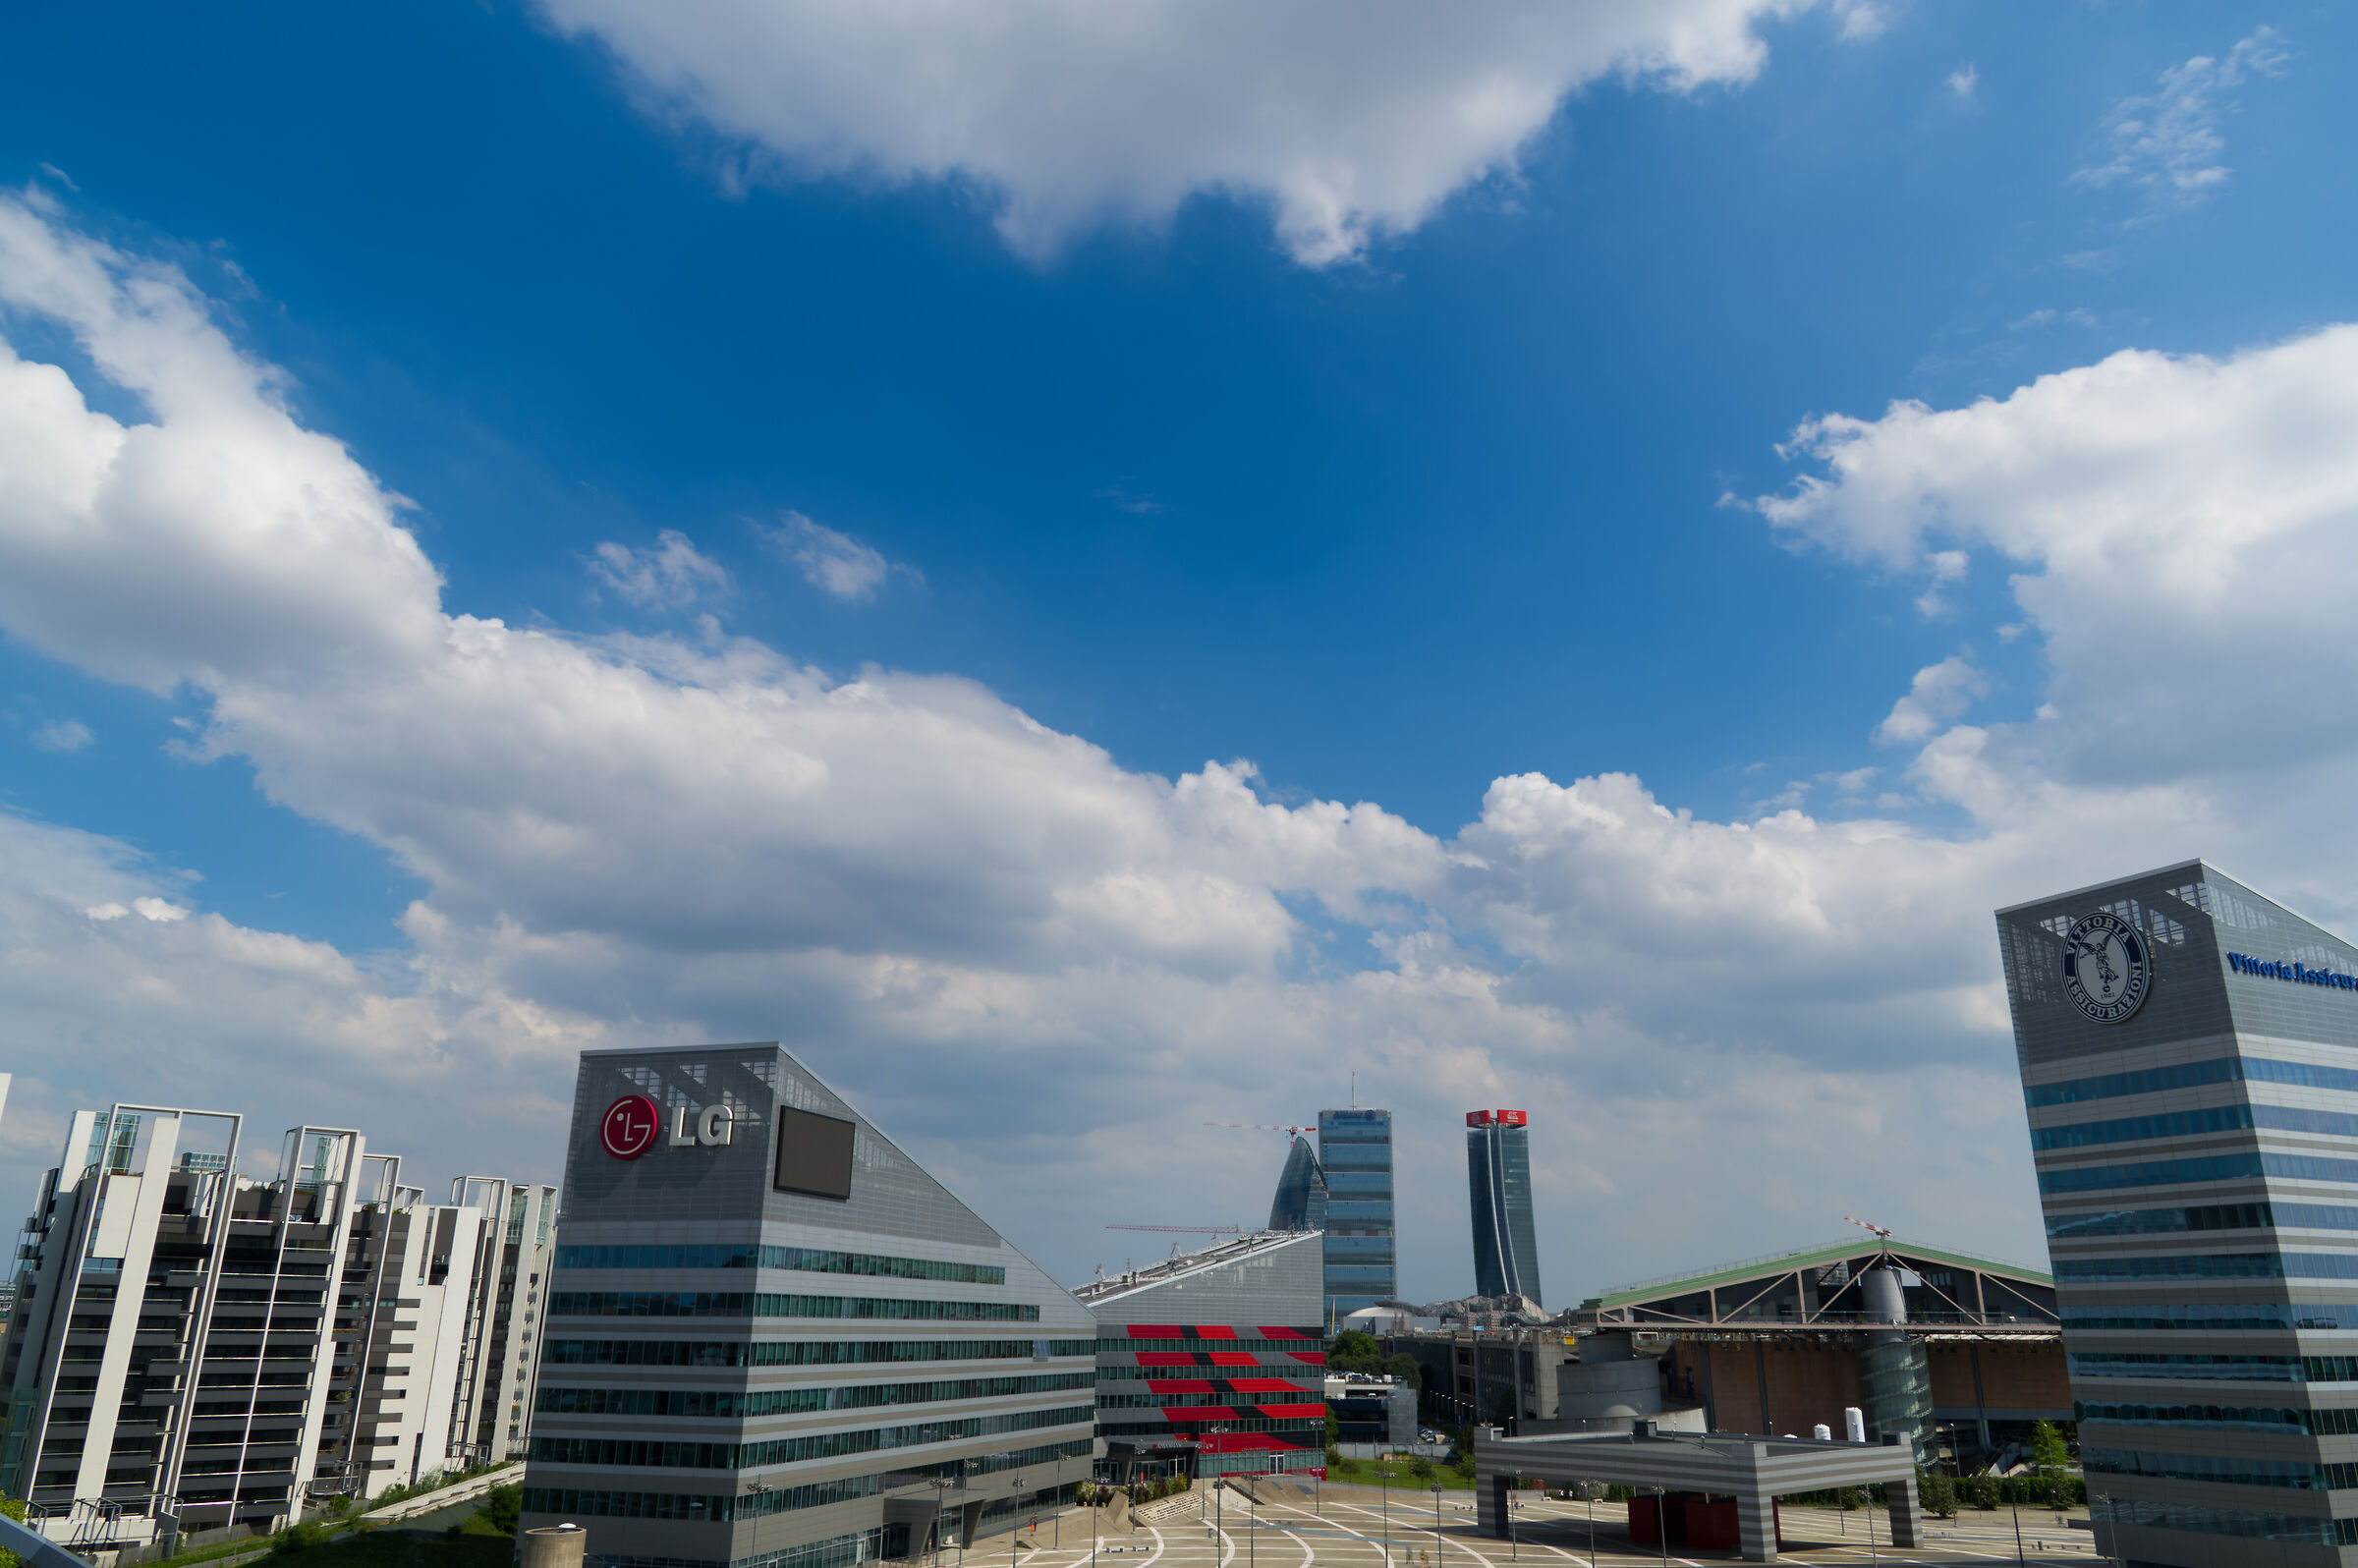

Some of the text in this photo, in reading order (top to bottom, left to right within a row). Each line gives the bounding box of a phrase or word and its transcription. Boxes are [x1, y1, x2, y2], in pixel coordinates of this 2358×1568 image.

[2066, 916, 2131, 955] VITTORIA
[2226, 951, 2294, 980] Vittoria
[2066, 961, 2143, 1018] ASSICURAZIONI
[669, 1104, 733, 1147] LG
